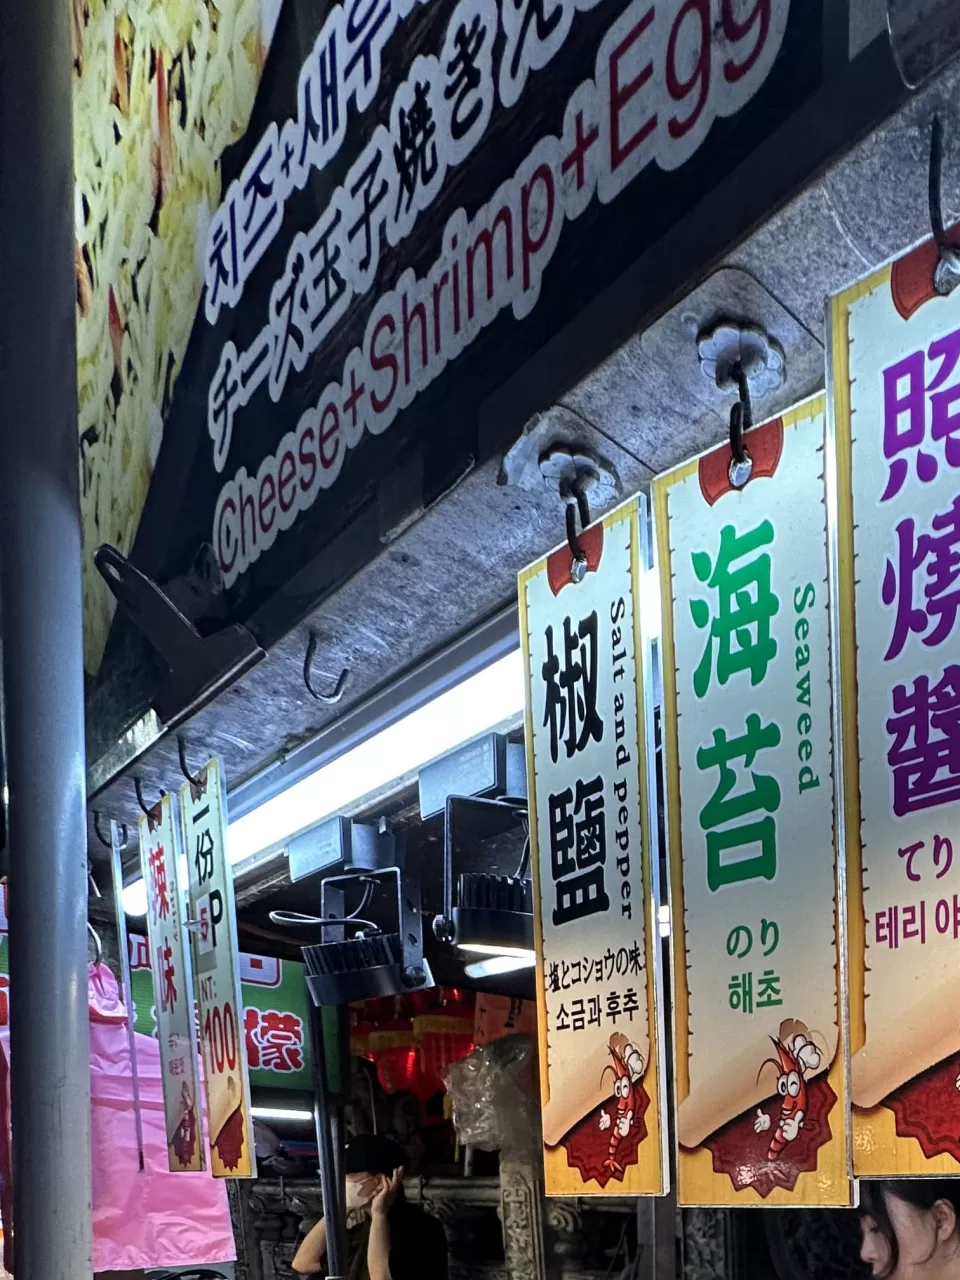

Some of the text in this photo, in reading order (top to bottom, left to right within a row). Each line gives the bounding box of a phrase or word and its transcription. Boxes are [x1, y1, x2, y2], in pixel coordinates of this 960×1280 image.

[688, 517, 782, 893] 海苔
[793, 582, 821, 795] Seaweed
[541, 609, 610, 926] 椒鹽
[609, 596, 633, 921] Salt and pepper
[192, 803, 214, 886] 一份
[548, 939, 643, 993] 塩とコショウの味
[726, 917, 780, 959] のり
[728, 969, 784, 1014] 해초
[204, 1001, 236, 1075] 100
